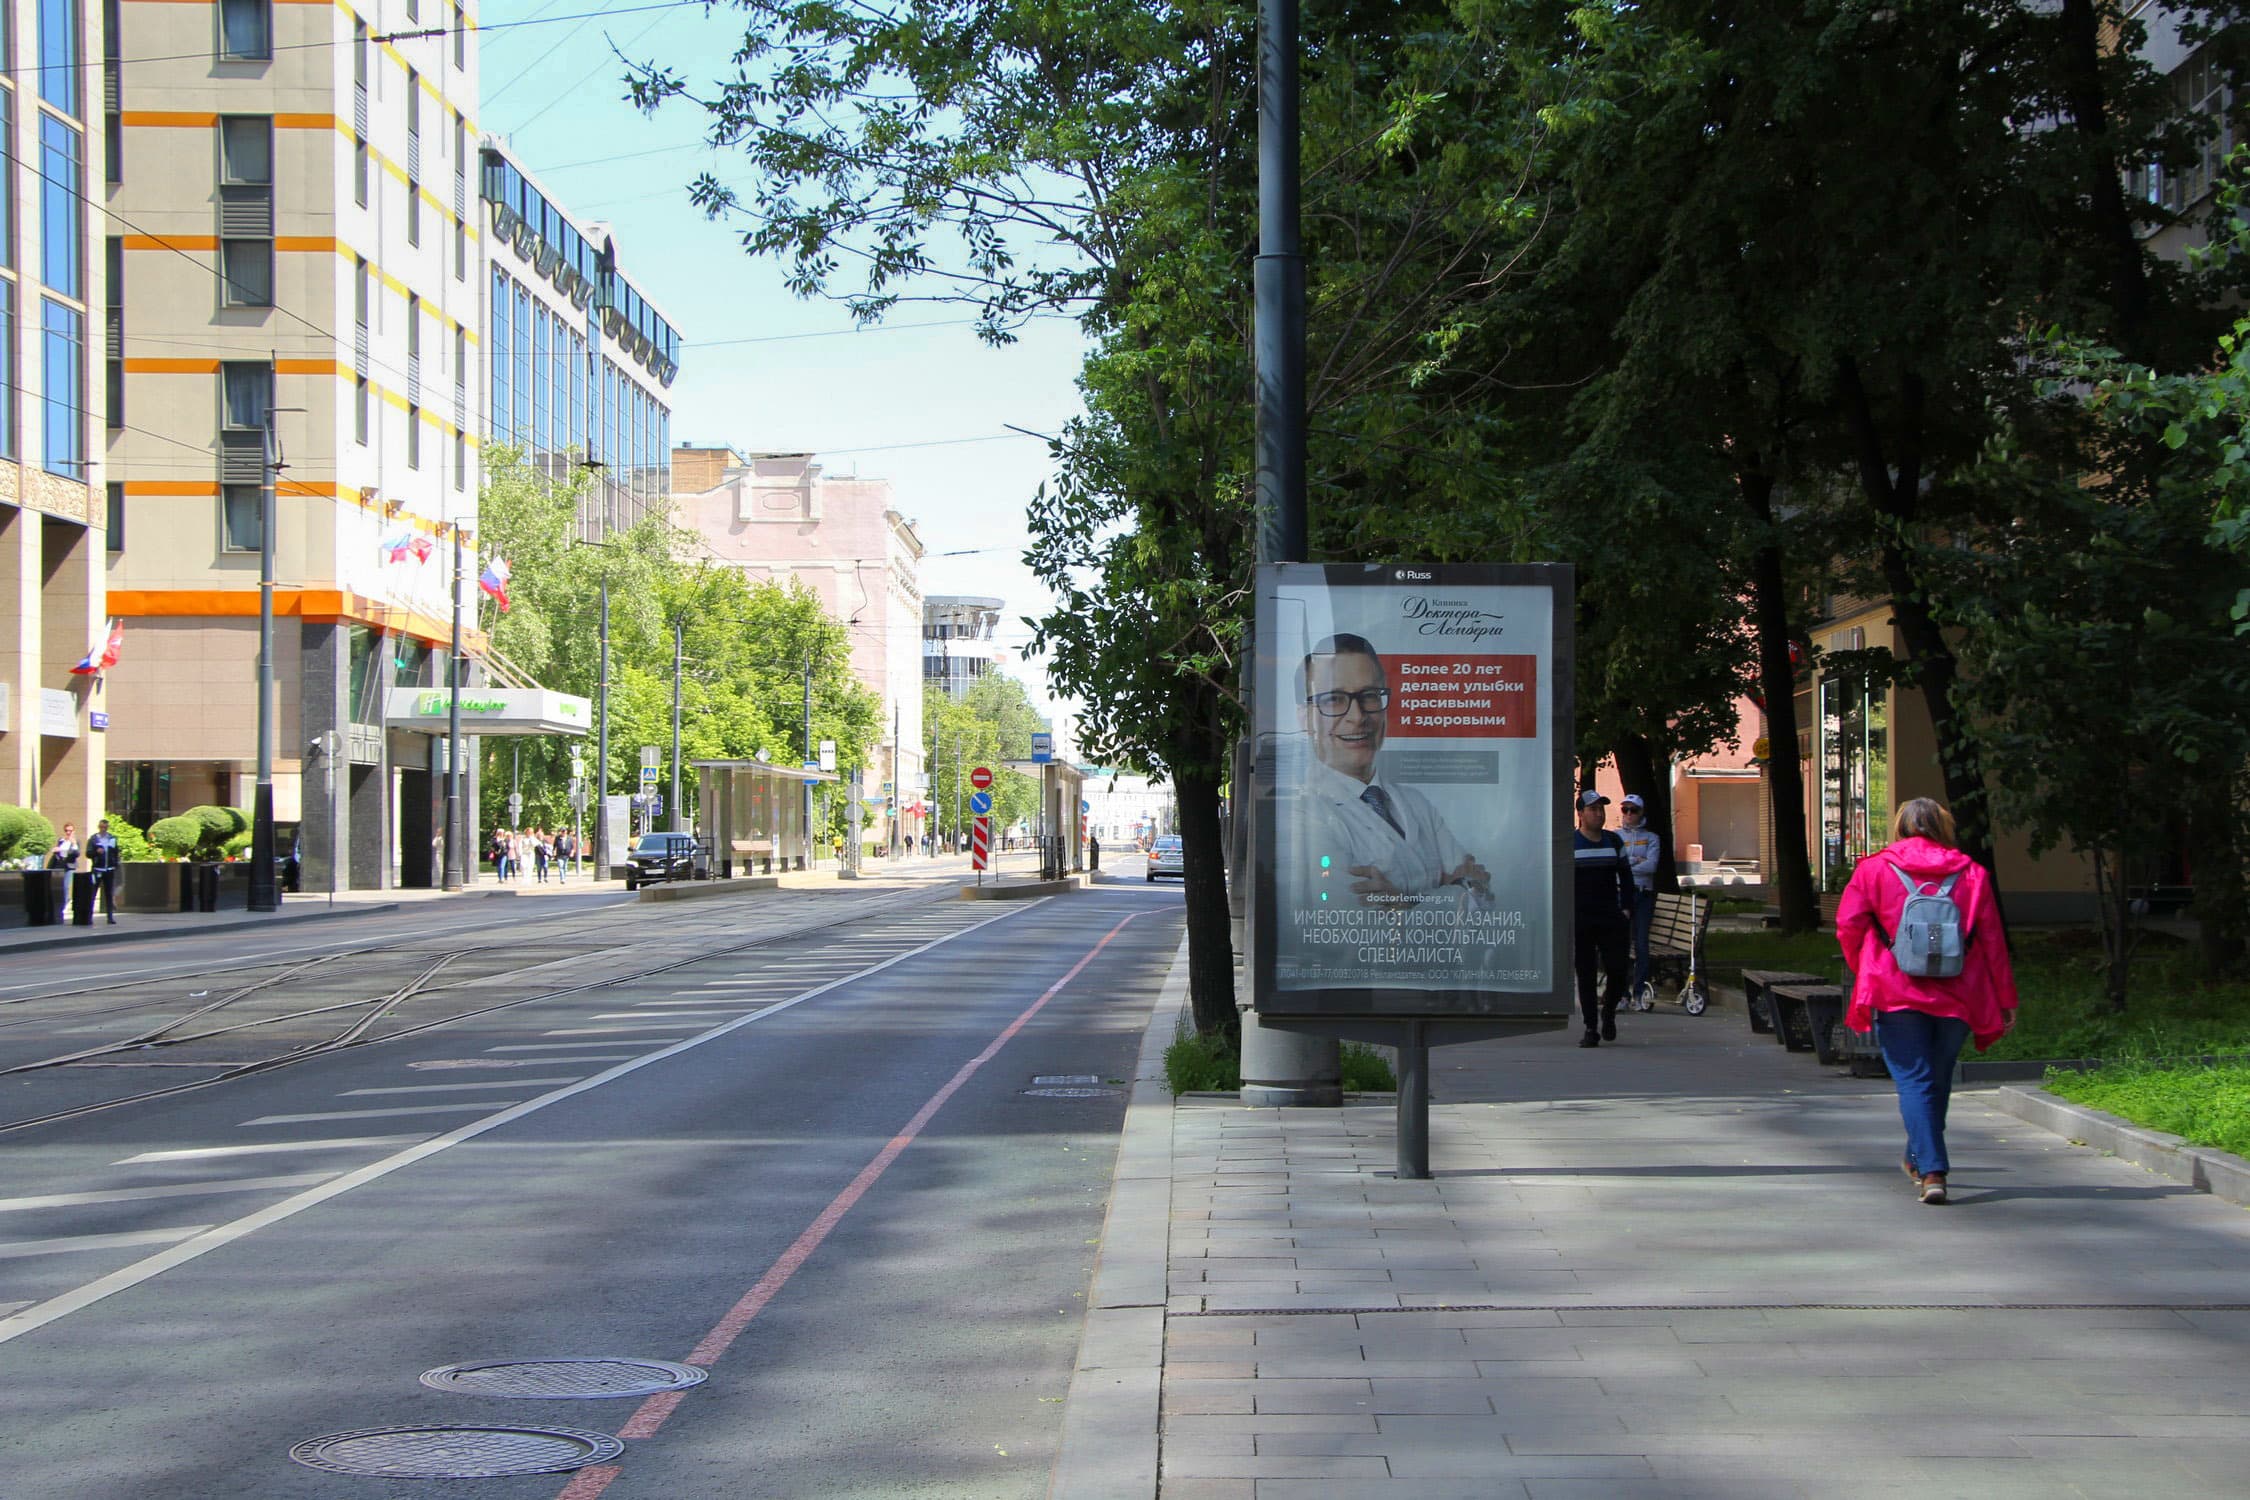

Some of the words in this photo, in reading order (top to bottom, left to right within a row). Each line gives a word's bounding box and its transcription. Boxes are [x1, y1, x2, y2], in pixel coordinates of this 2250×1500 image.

[1406, 570, 1432, 580] Russ
[1431, 599, 1468, 607] Клиника
[1400, 596, 1504, 623] Доктора
[1418, 620, 1504, 643] Лемберга
[1401, 663, 1449, 675] Более
[1453, 663, 1472, 675] 20
[1475, 665, 1503, 675] лет
[1401, 682, 1460, 693] делаем
[1463, 680, 1524, 693] улыбки
[1401, 699, 1491, 710] красивыми
[1401, 716, 1411, 725] и
[1415, 716, 1506, 727] здоровыми
[1366, 893, 1454, 905] doctorlemberg.ru
[1294, 910, 1363, 925] ИМЕЮТСЯ
[1368, 910, 1526, 928] ПРОТИВОПОКАЗАНИЯ,
[1303, 929, 1402, 947] НЕОБХОДИМА
[1405, 929, 1516, 947] КОНСУЛЬТАЦИЯ
[1358, 947, 1463, 965] СПЕЦИАЛИСТА
